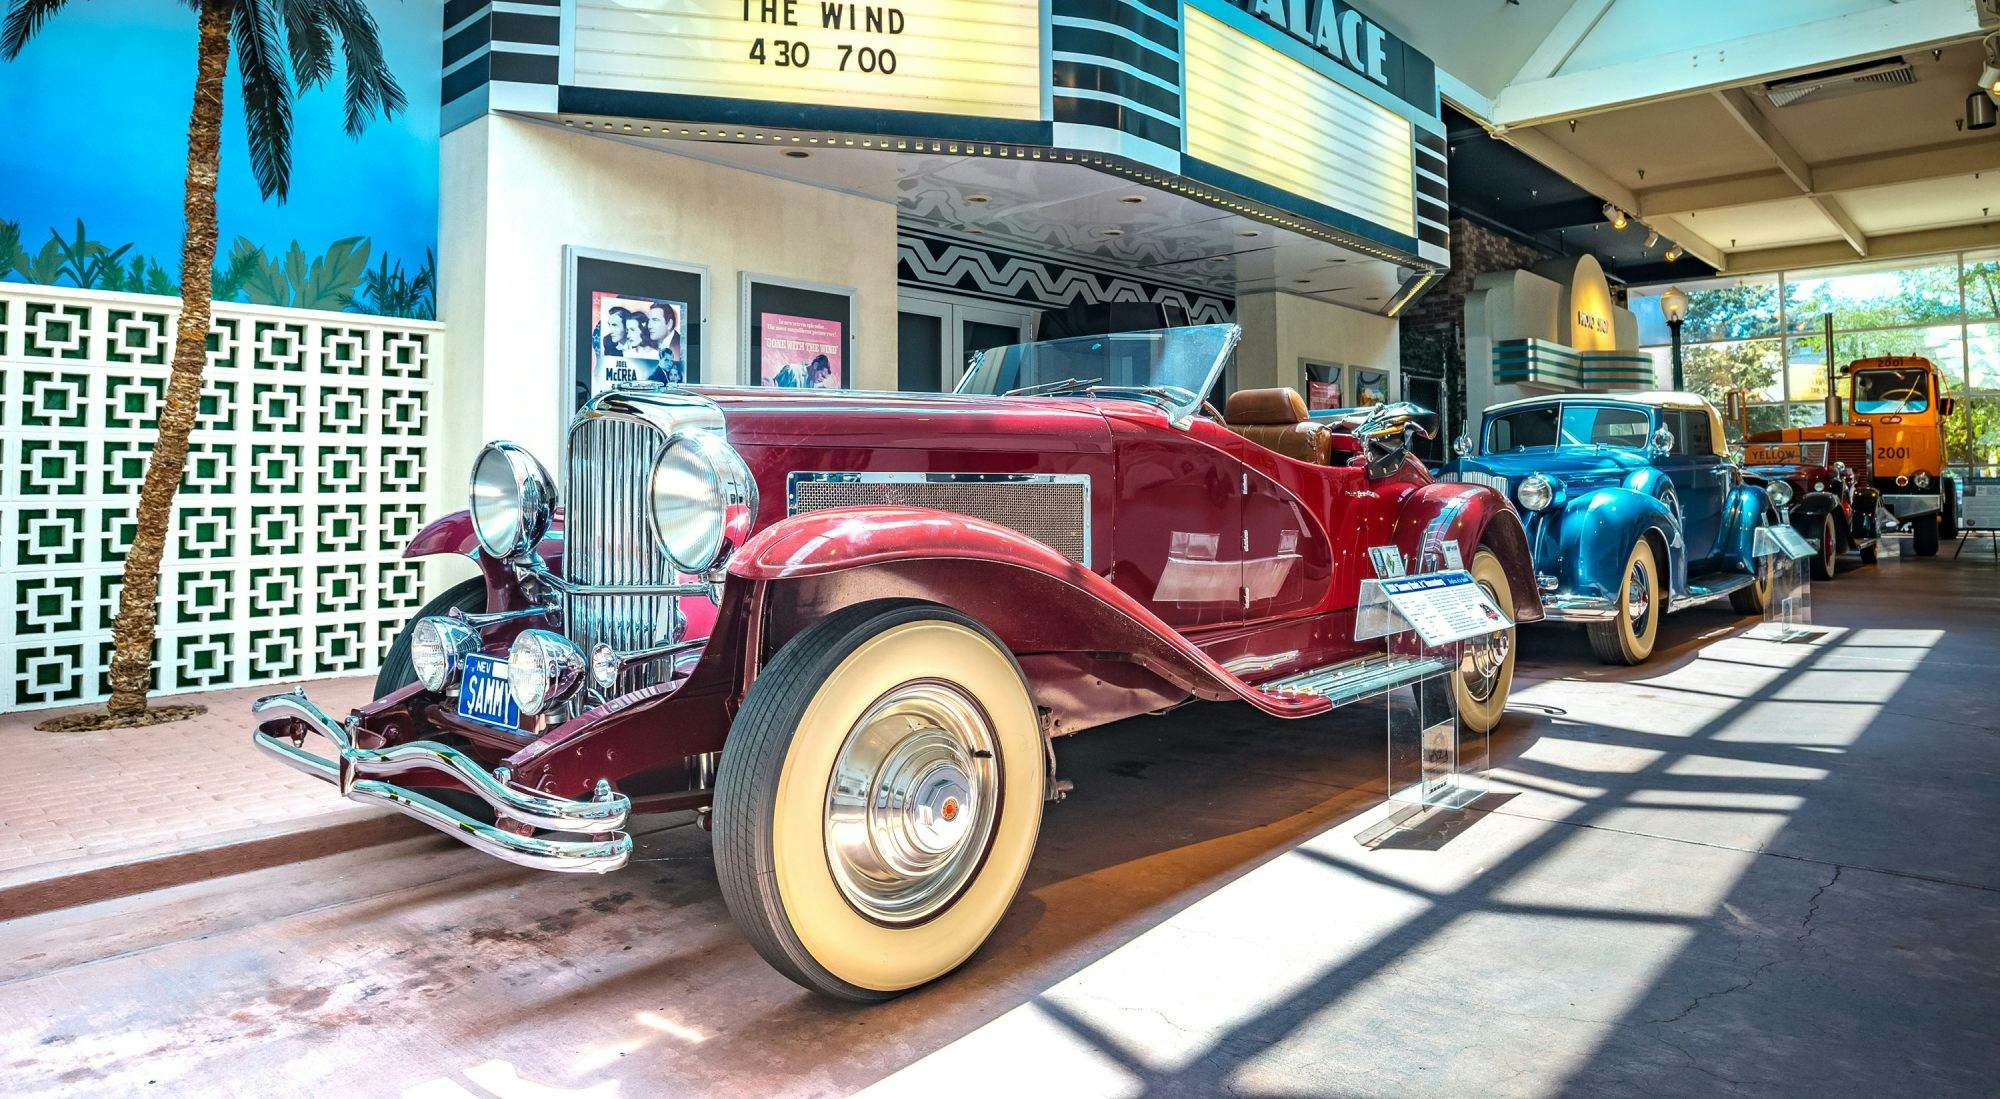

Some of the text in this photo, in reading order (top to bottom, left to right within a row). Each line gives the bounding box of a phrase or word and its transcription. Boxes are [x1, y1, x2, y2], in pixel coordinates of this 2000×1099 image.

[743, 0, 904, 34] THE WIND
[749, 38, 897, 75] 430 700
[1878, 358, 1904, 367] 2001
[605, 368, 637, 381] McCREA
[1752, 451, 1796, 460] YELLOW
[1878, 447, 1910, 459] 2001
